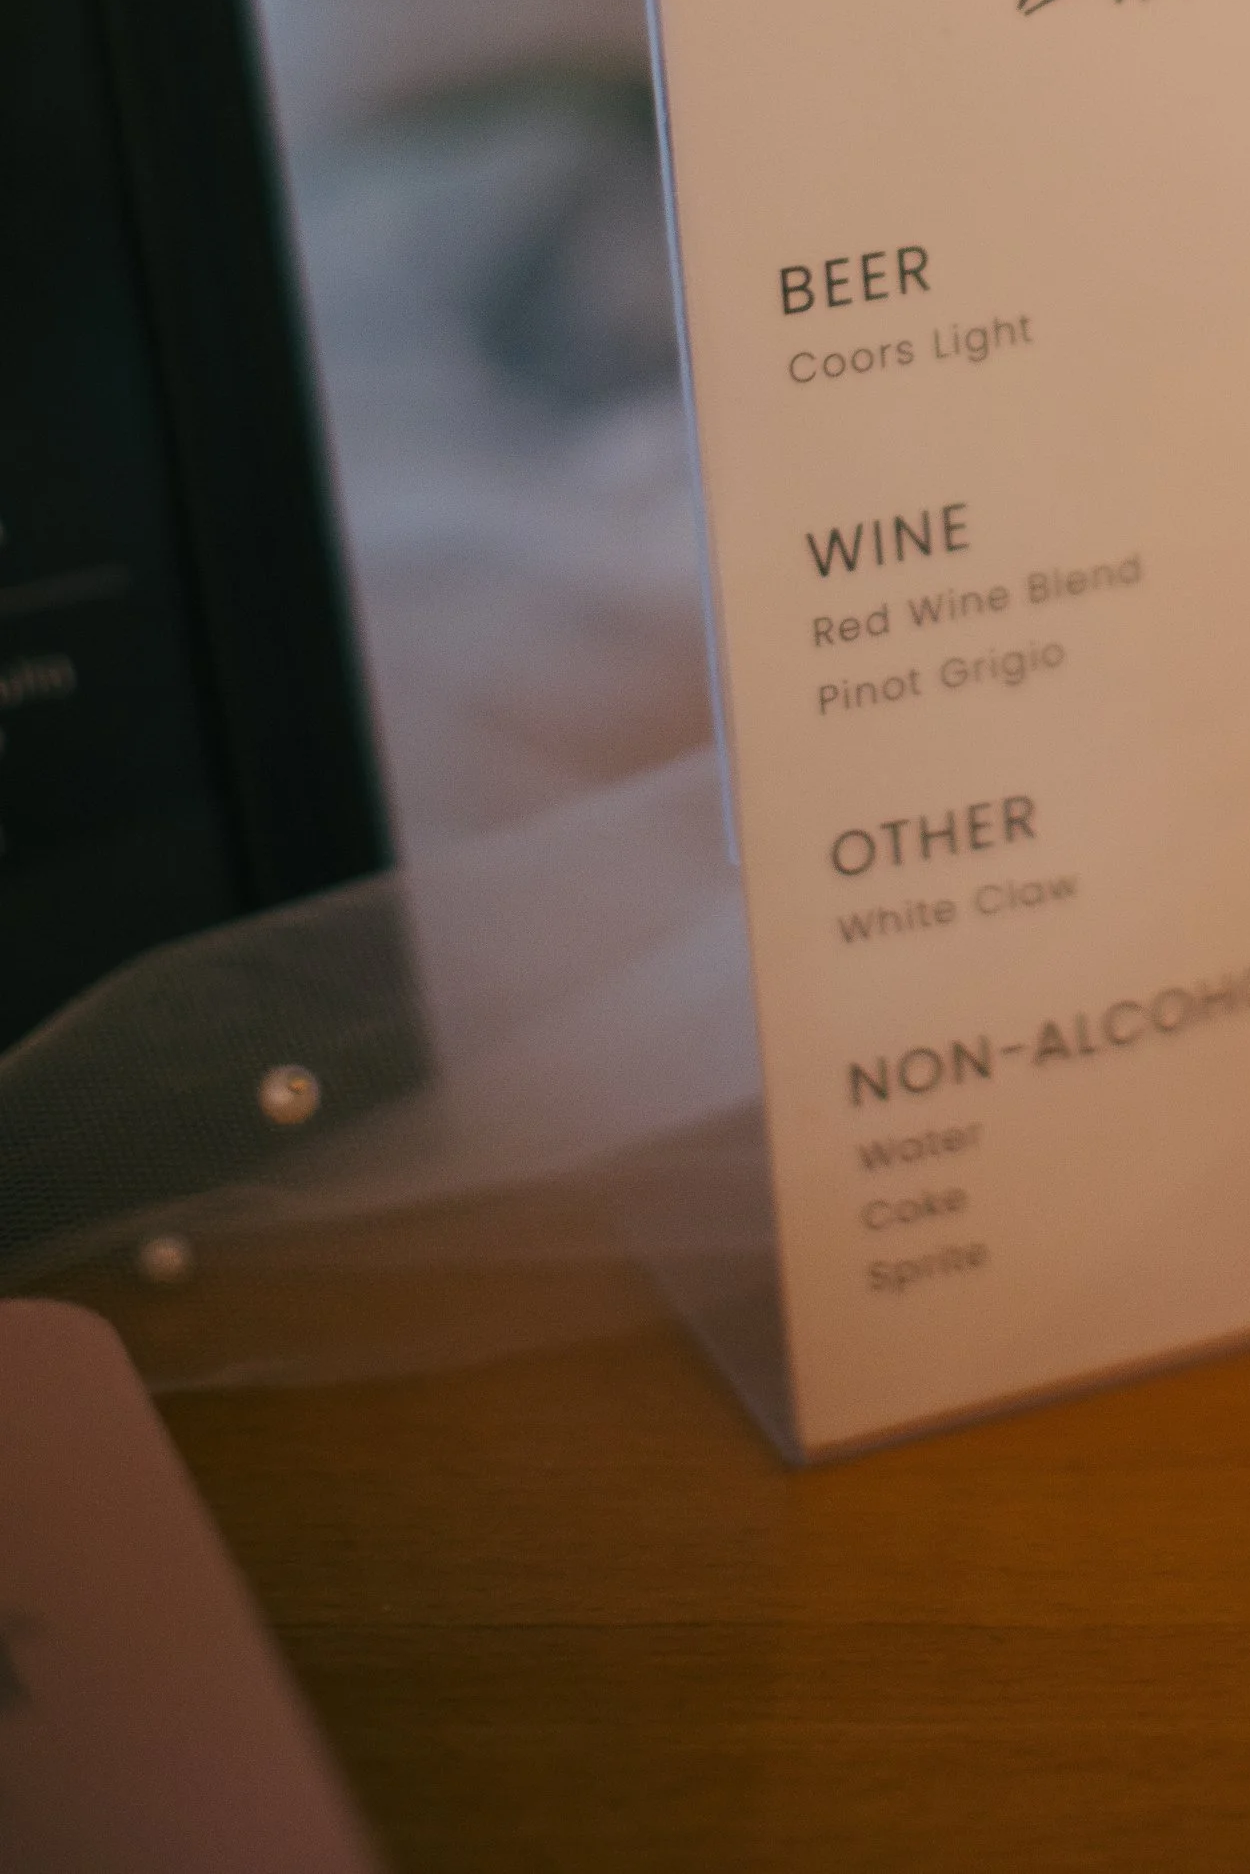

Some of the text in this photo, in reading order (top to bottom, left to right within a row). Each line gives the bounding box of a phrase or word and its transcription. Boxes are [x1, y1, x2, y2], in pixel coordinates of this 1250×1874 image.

[779, 245, 931, 315] BEER
[788, 313, 1034, 384] Coors Light
[805, 502, 971, 578] WINE
[812, 552, 1143, 647] Red Wine Blend
[817, 639, 1066, 716] Pinot Grigio
[830, 794, 1036, 877] OTHER
[838, 874, 1080, 944] White Claw
[857, 1124, 982, 1171] Water
[861, 1188, 969, 1230] Coke
[867, 1242, 989, 1294] Sprite
